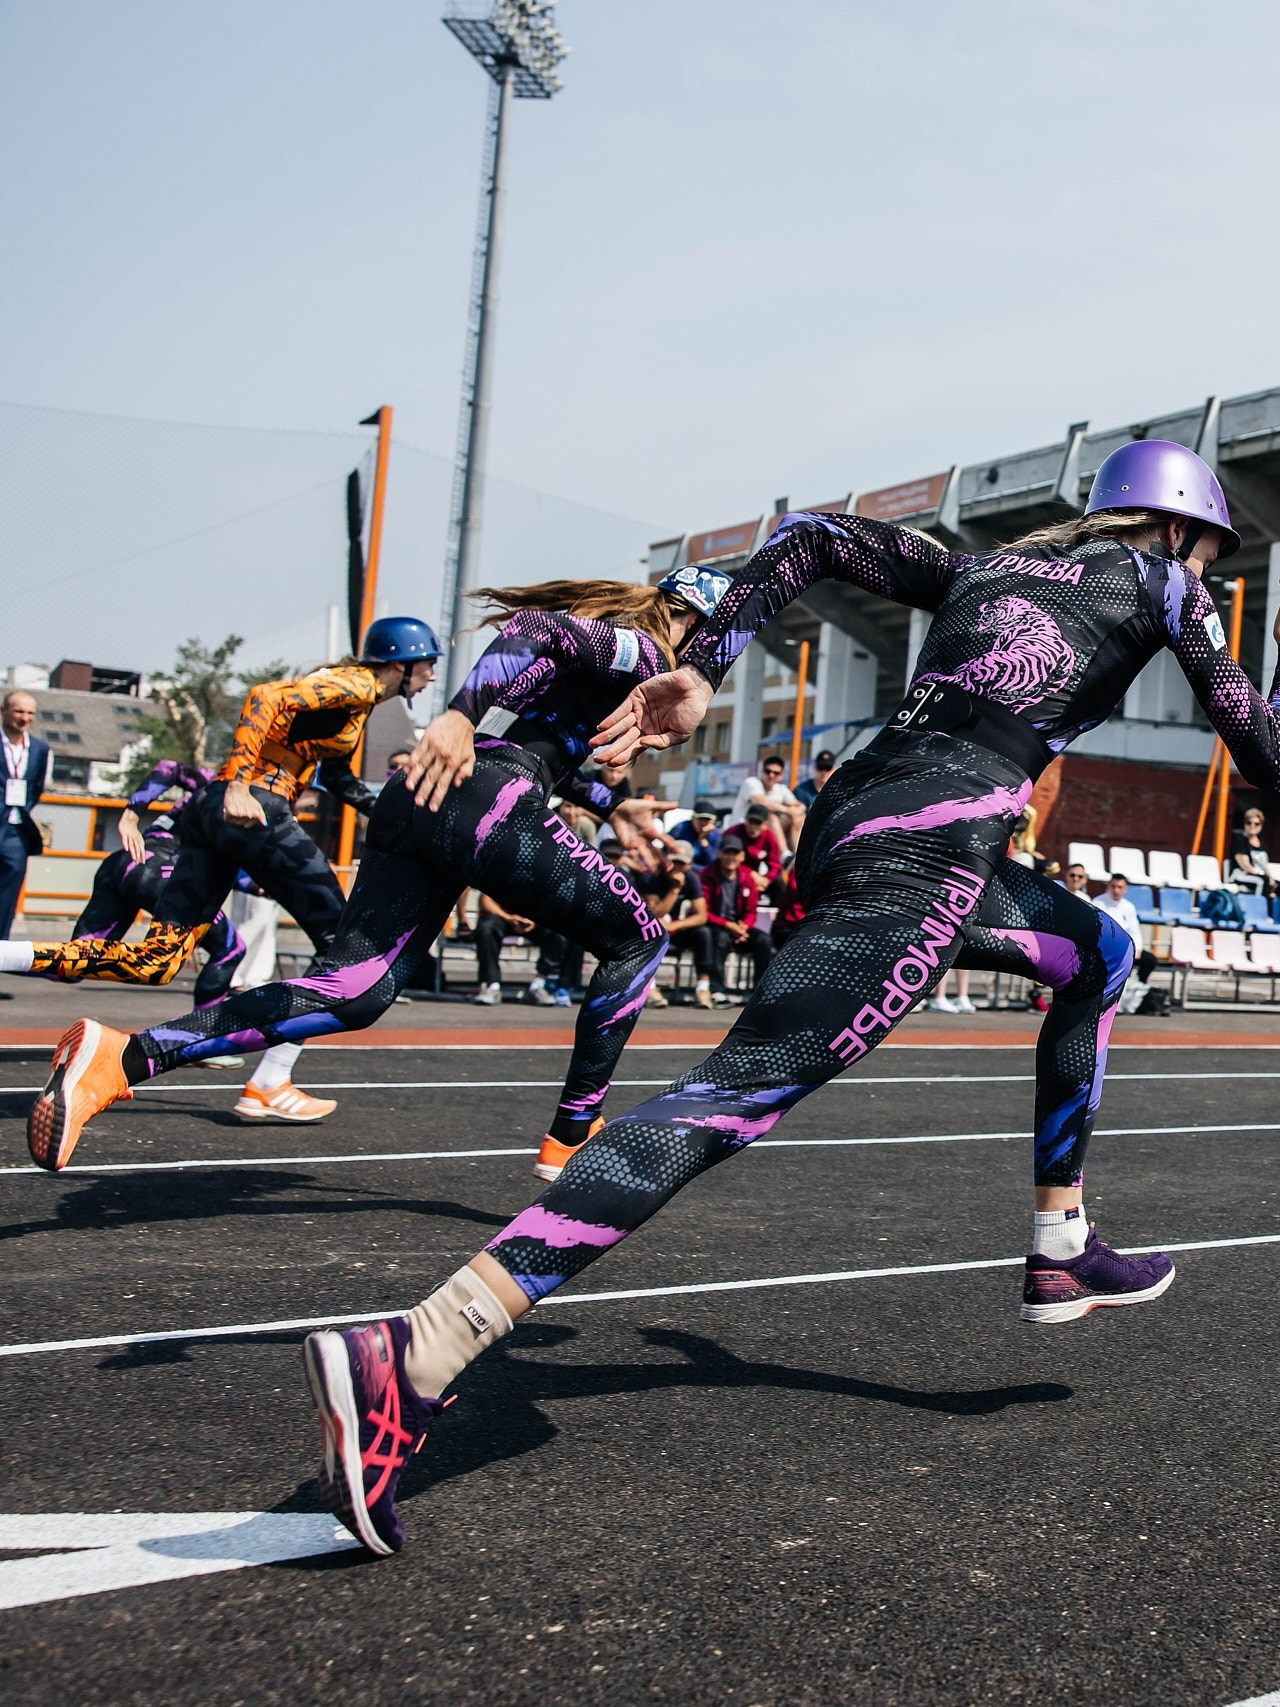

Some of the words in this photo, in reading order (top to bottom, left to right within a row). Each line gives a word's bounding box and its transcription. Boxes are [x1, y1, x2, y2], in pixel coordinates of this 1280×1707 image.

[984, 554, 1085, 586] ГРУЛЕВА
[543, 813, 662, 942] ПРИМОРЬЕ
[828, 865, 986, 1068] ПРИМОРЬЕ
